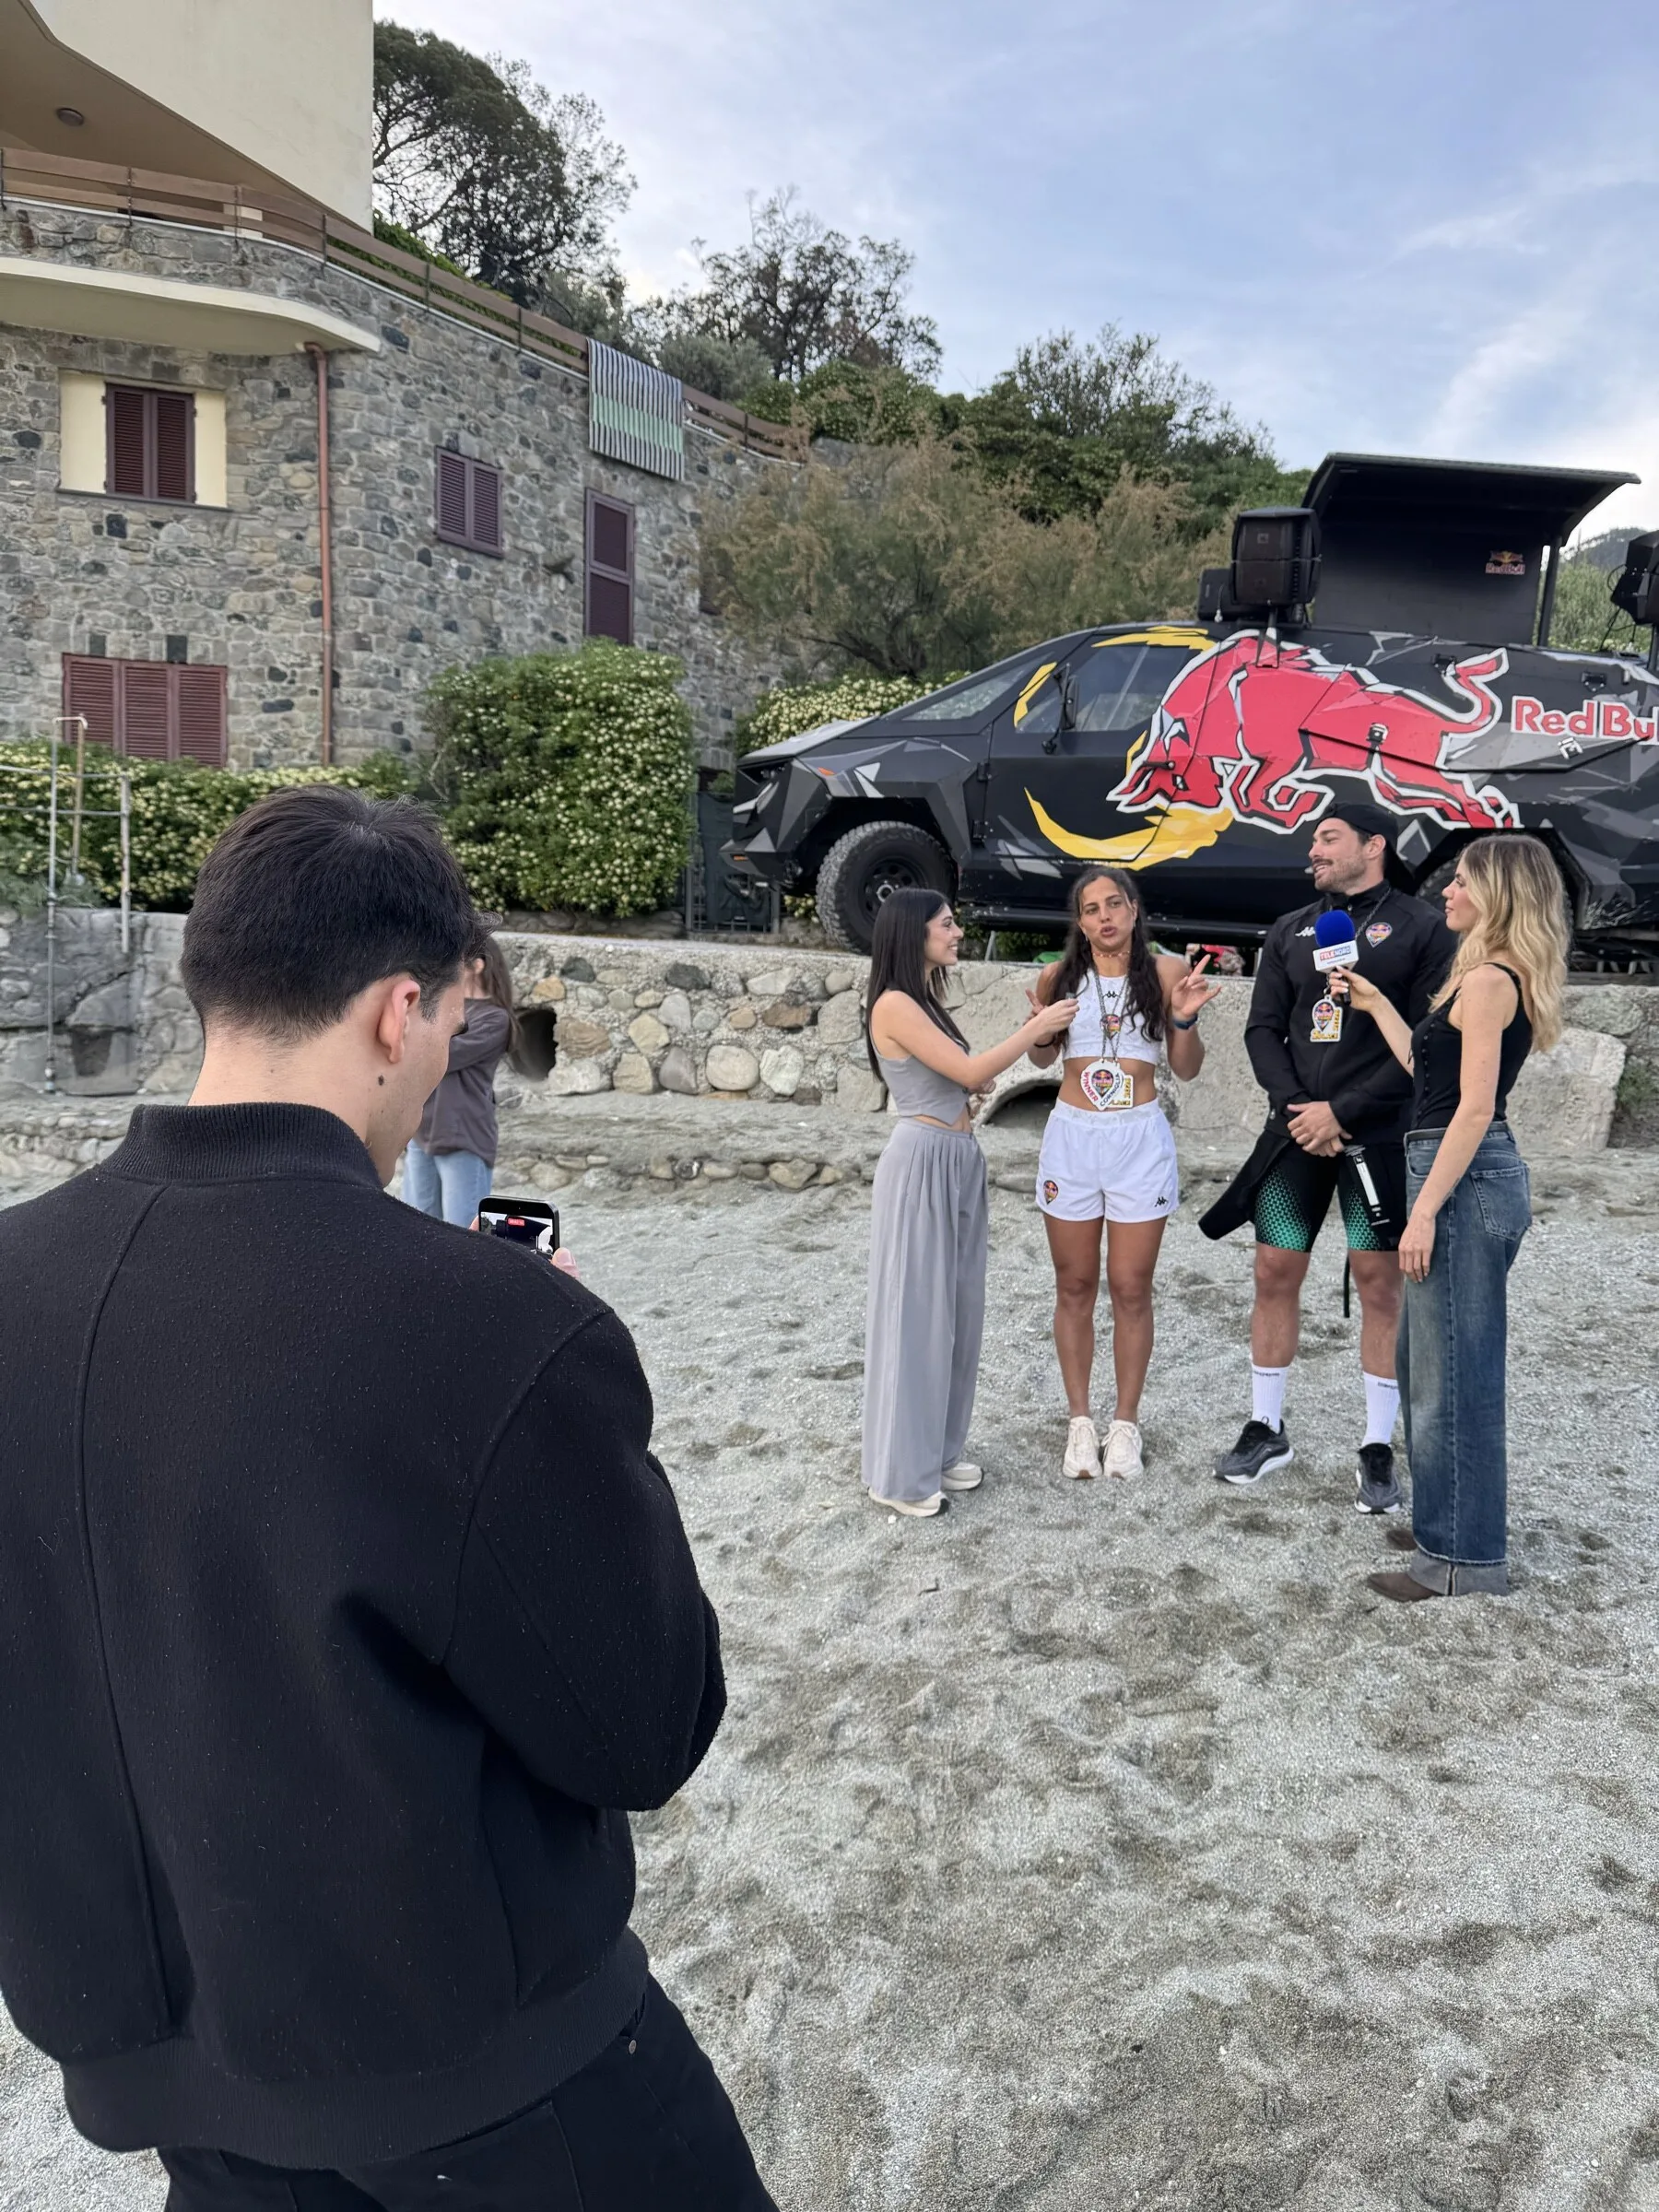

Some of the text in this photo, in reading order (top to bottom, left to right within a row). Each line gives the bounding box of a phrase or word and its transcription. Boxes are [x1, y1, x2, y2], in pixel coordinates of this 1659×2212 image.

[1515, 698, 1659, 741] Red Bu
[1083, 1071, 1099, 1101] WINNER
